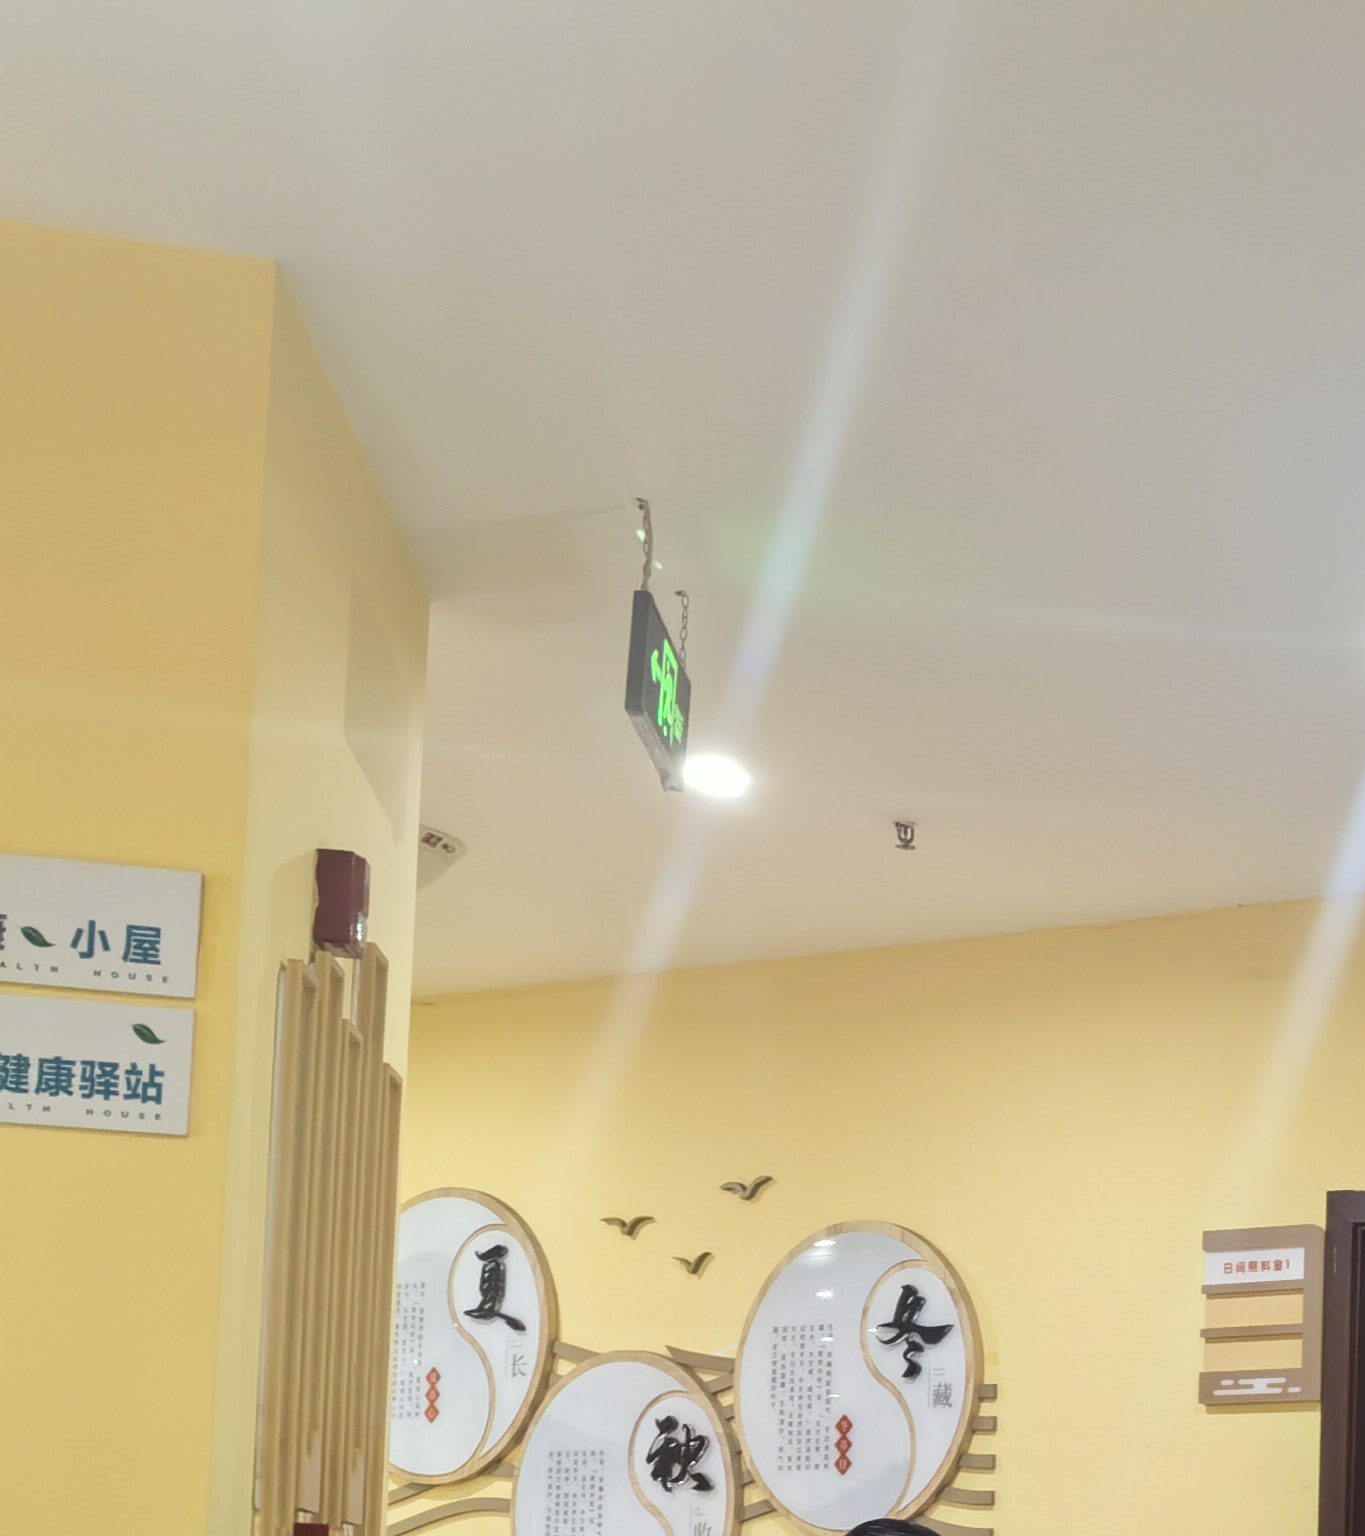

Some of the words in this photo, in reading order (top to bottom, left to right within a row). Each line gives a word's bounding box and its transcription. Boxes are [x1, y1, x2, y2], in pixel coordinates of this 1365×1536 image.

[70, 920, 161, 965] 小屋
[93, 970, 169, 984] HOUSE
[0, 1053, 165, 1105] 健康驿站
[86, 1108, 161, 1120] HOUSE
[464, 1244, 526, 1332] 夏
[875, 1284, 954, 1378] 冬
[646, 1415, 715, 1492] 秋
